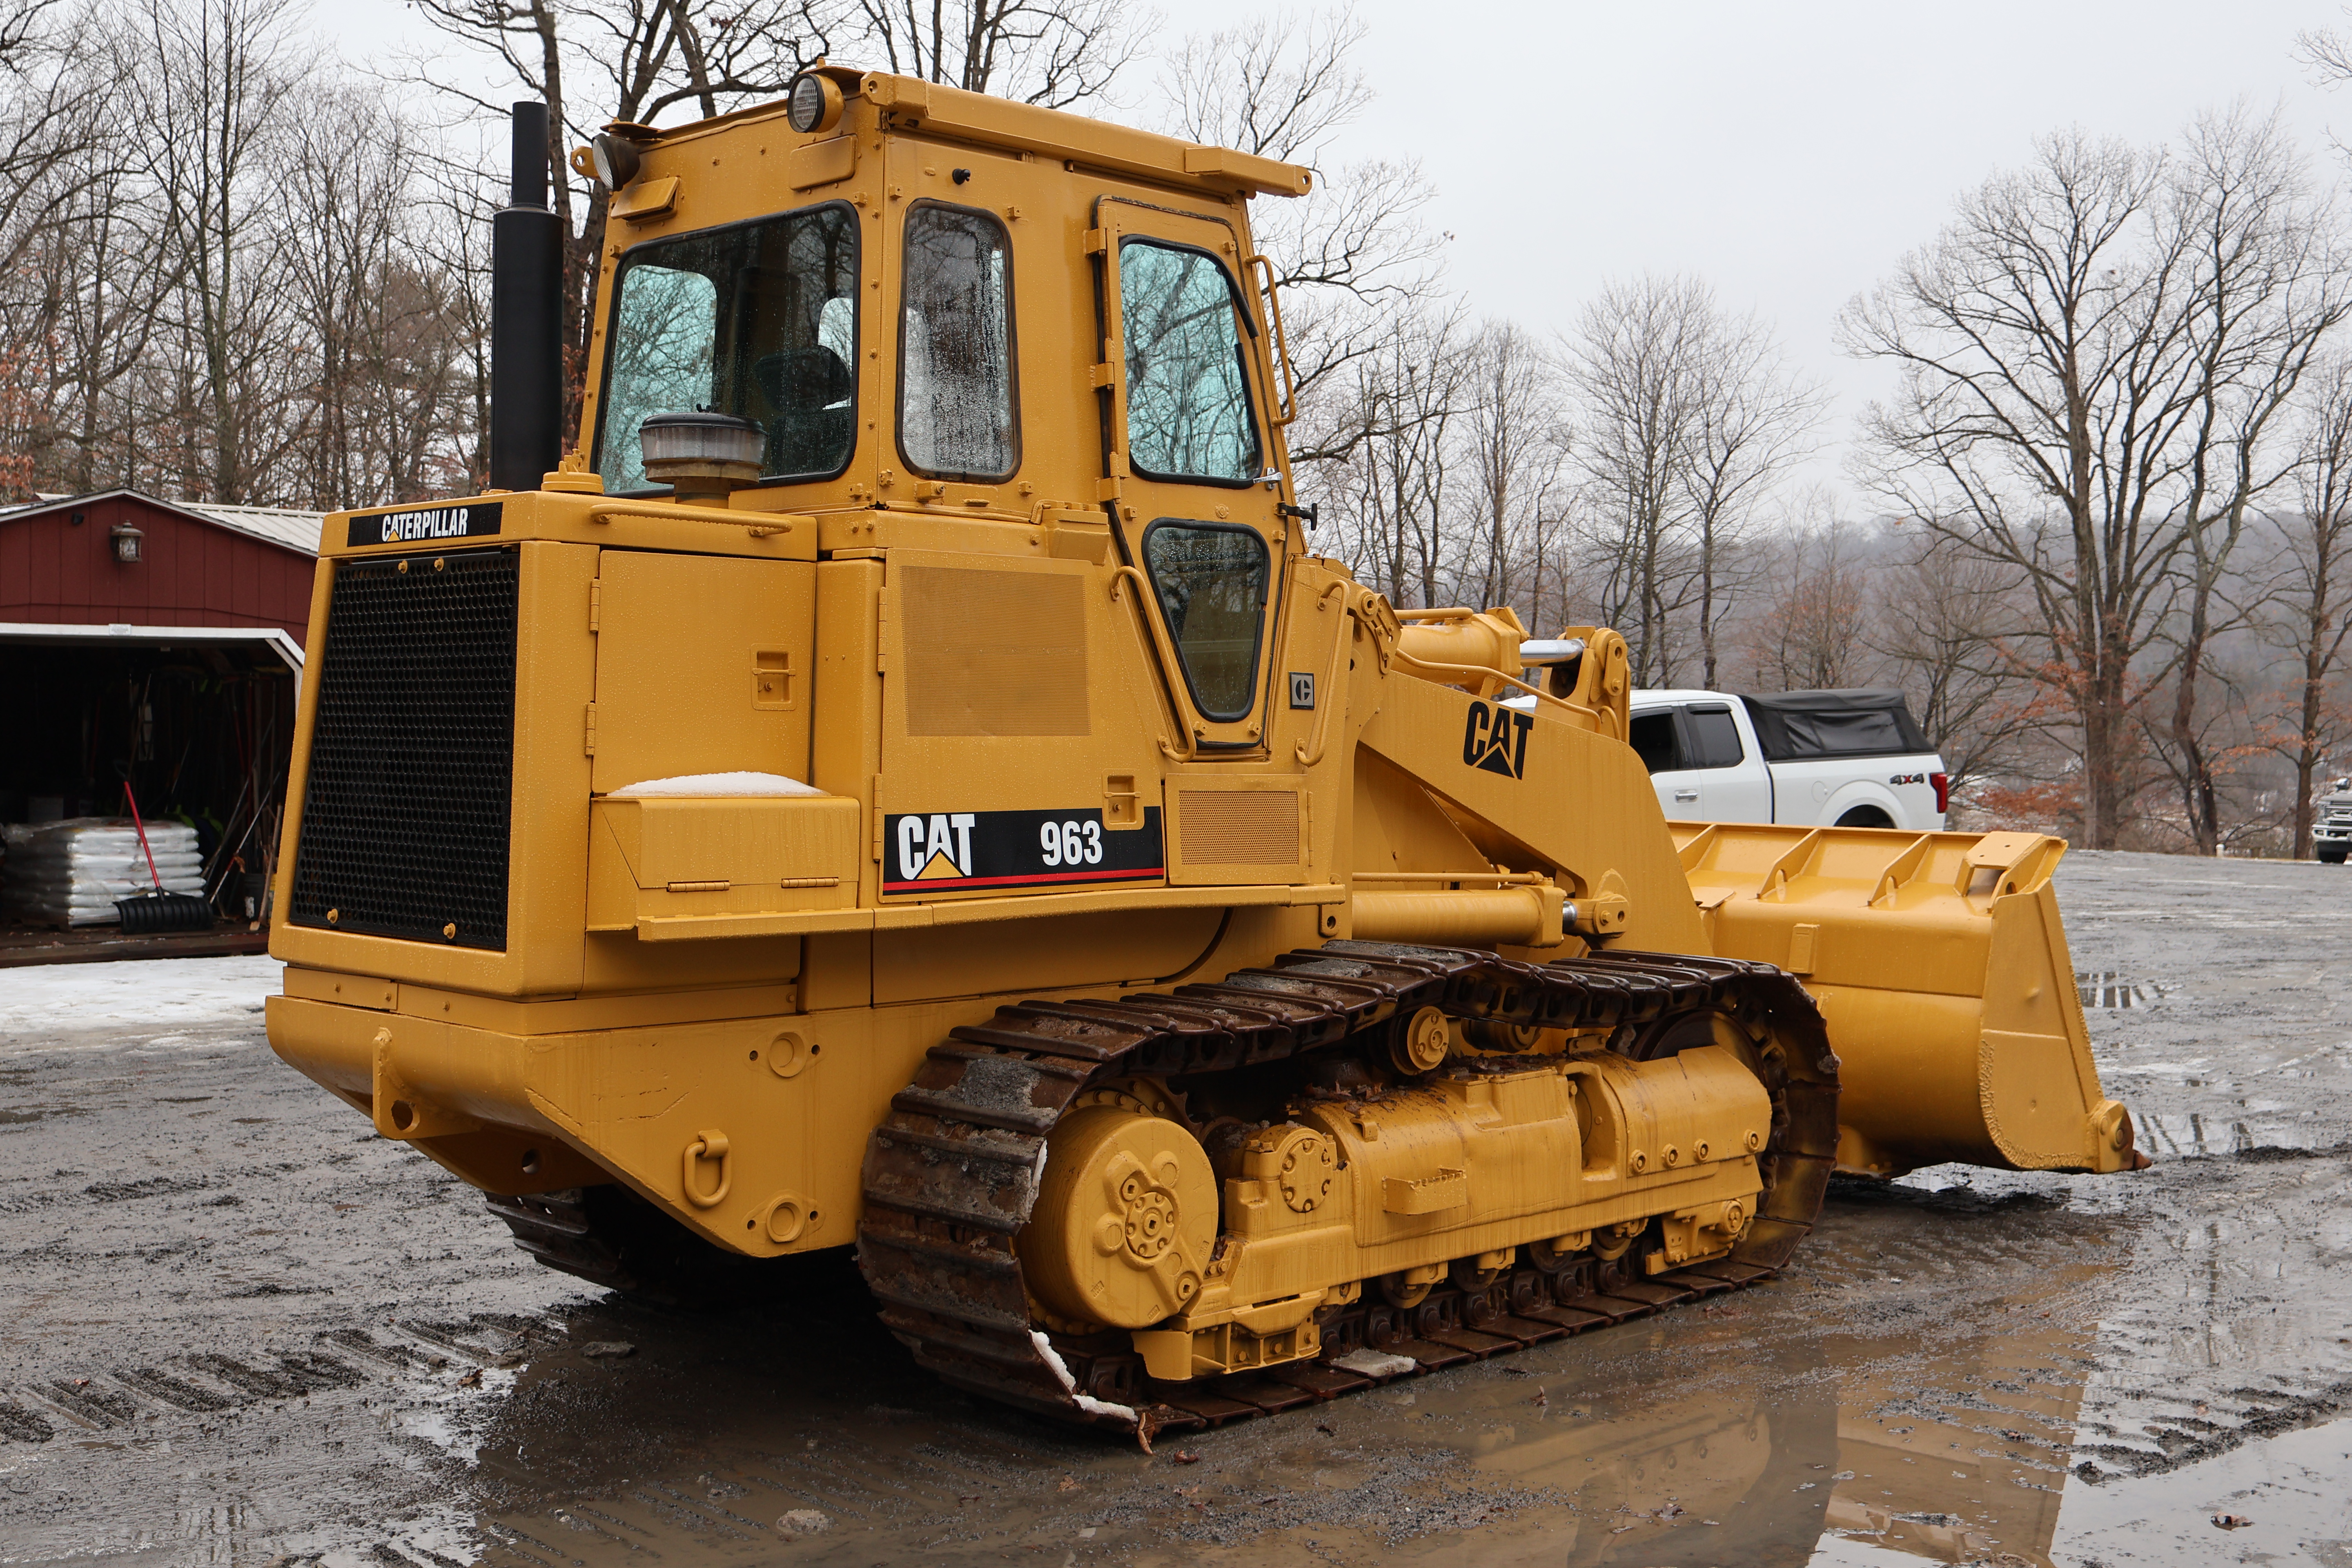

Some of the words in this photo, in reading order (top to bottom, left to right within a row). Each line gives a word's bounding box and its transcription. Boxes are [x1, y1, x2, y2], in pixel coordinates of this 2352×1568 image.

[381, 508, 468, 542] CATERPILLAR
[1463, 701, 1534, 780] CAT
[898, 813, 975, 880] CAT
[1040, 820, 1102, 866] 963
